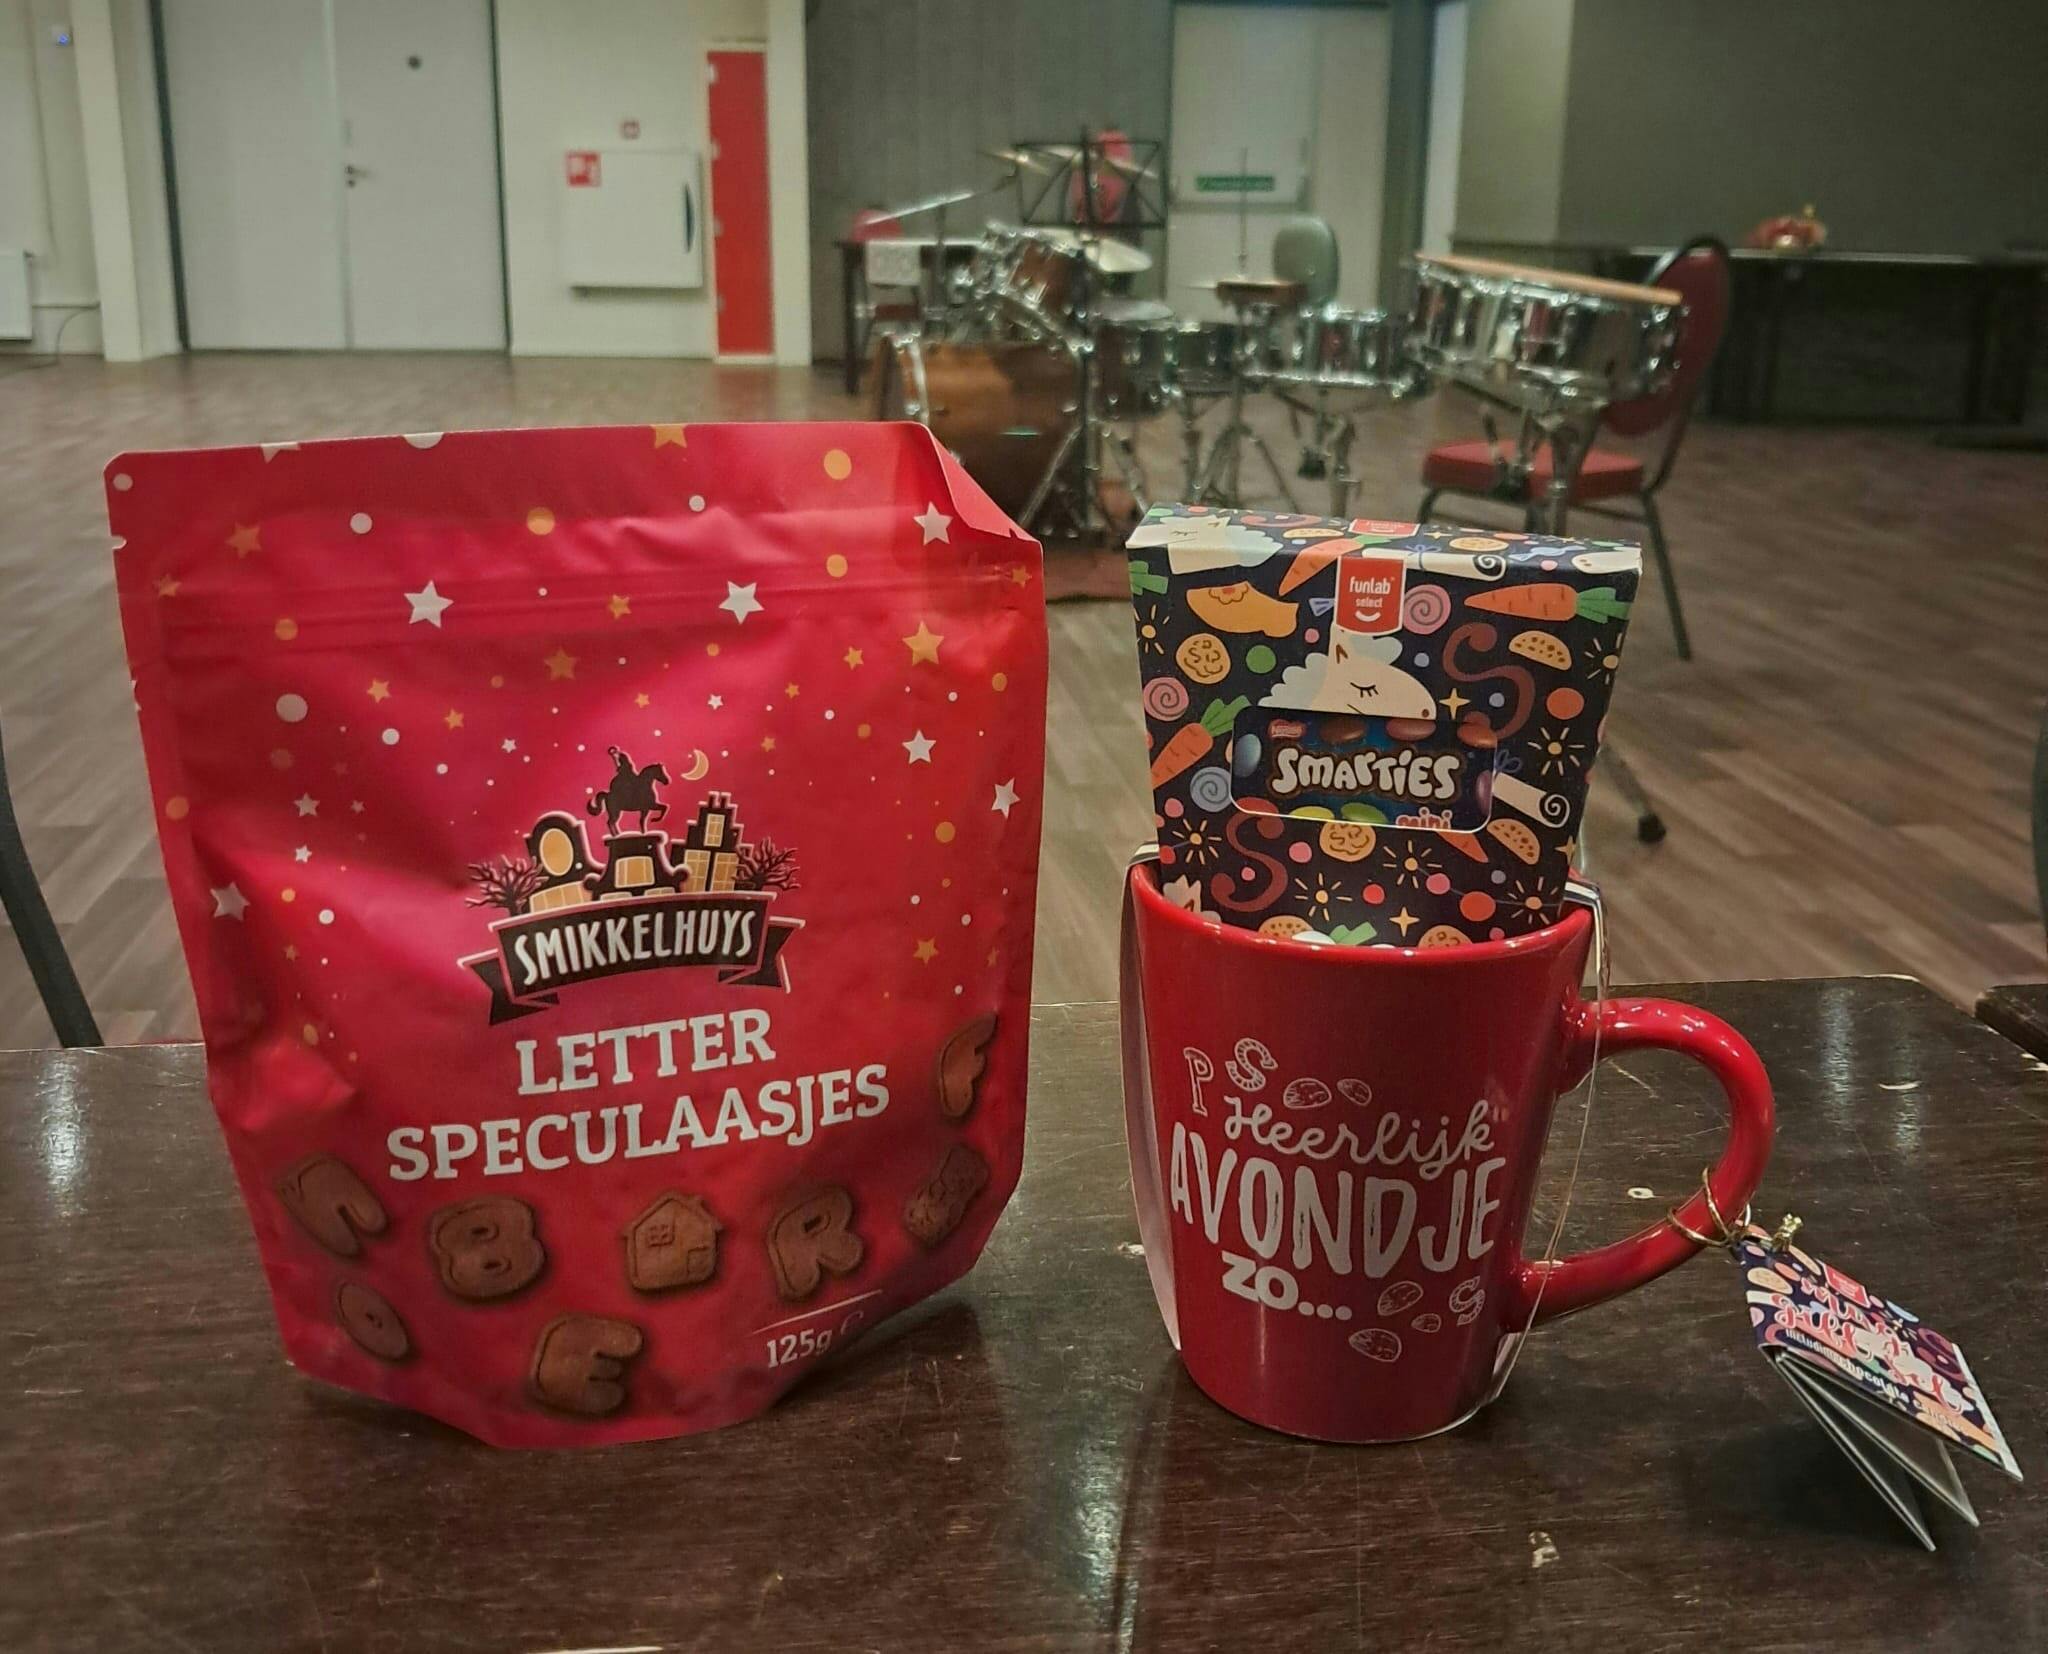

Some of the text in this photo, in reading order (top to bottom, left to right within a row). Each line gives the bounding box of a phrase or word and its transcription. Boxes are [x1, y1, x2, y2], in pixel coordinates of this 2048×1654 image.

[1349, 575, 1391, 593] funlab
[514, 908, 756, 986] SMIKKELHUYS
[515, 1008, 776, 1096] LETTER
[386, 1064, 890, 1182] SPECULAASJES
[1223, 1096, 1495, 1180] Heerlijk
[1170, 1122, 1506, 1279] AVONDJE
[766, 1328, 833, 1369] 125g
